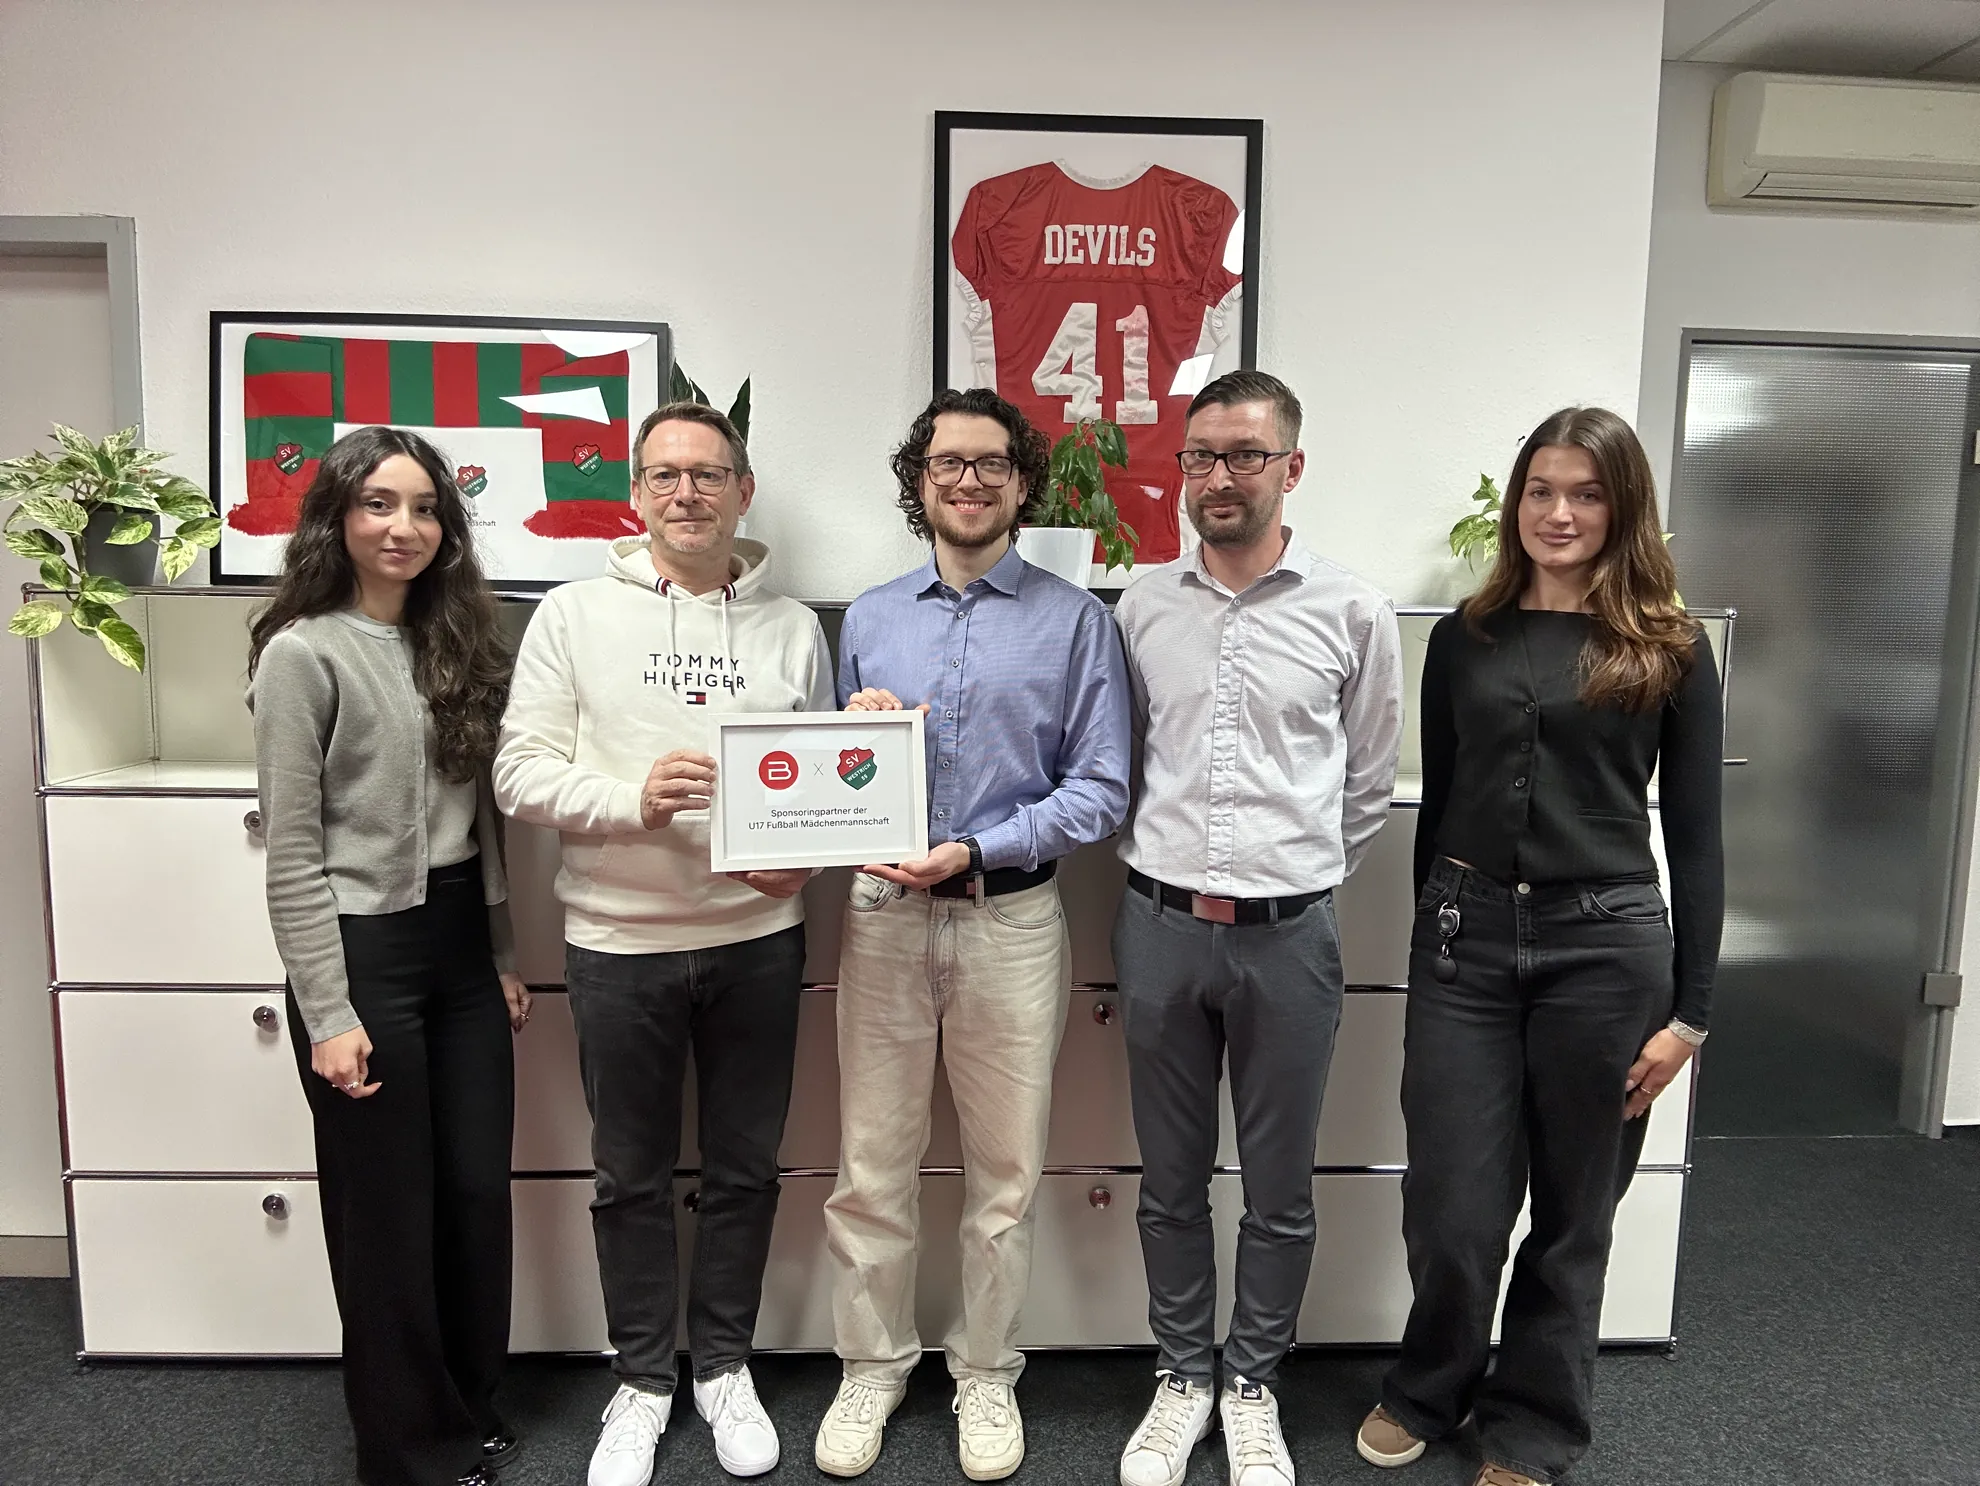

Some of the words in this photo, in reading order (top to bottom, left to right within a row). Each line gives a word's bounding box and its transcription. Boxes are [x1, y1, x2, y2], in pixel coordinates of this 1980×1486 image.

[1044, 224, 1156, 266] DEVILS
[1032, 302, 1158, 424] 41
[280, 446, 291, 458] SV
[578, 448, 589, 460] SV
[462, 470, 474, 481] SV
[648, 653, 739, 671] TOMMY
[644, 671, 746, 689] HILFIGER
[845, 753, 859, 768] SV
[847, 763, 871, 782] WESTRICH
[771, 808, 851, 818] Sponsoringpartner
[767, 820, 798, 829] Fußball
[800, 816, 890, 828] Mädchenmannschaft
